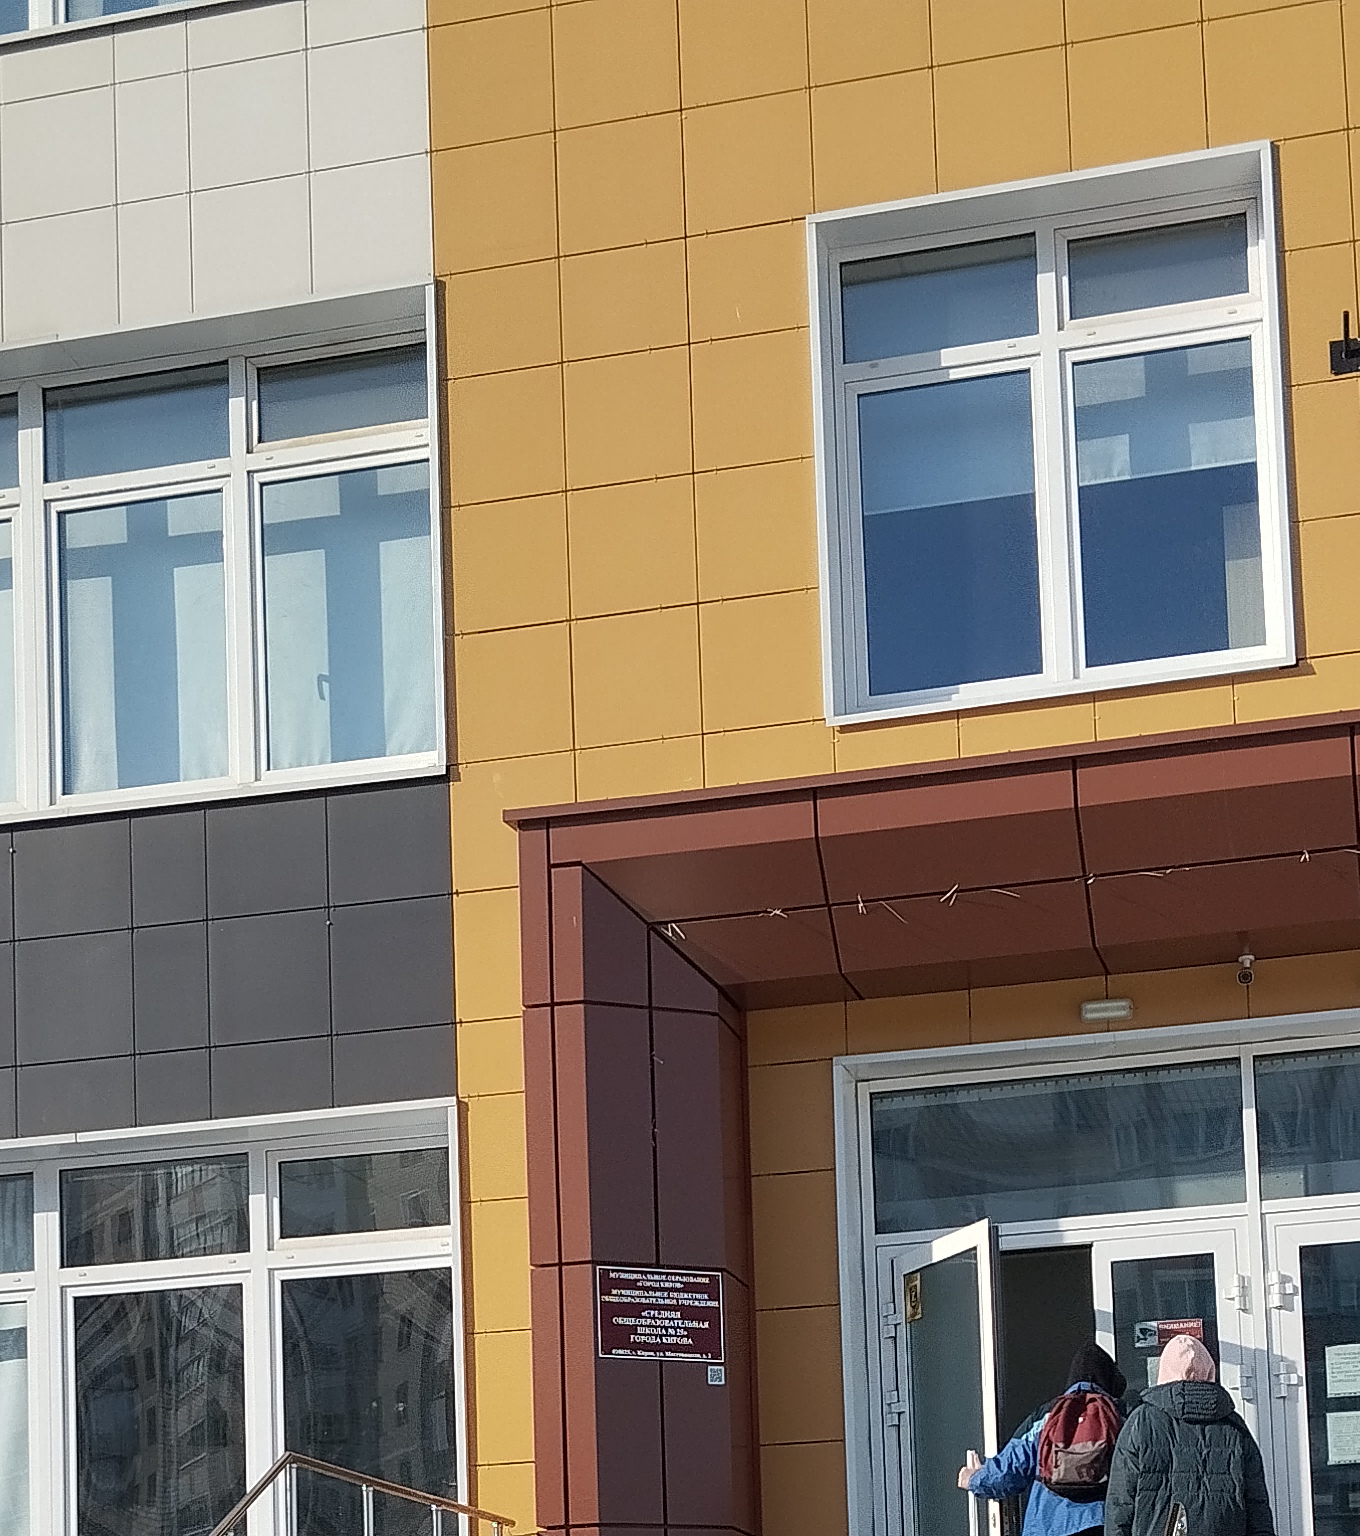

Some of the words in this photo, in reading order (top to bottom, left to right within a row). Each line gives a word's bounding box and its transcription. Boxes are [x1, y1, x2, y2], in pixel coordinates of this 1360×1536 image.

[612, 1317, 709, 1328] ОБЩЕОБРАЗОВАТЕЛЬНАЯ
[637, 1326, 666, 1335] ШКОЛА
[630, 1335, 661, 1344] ГОРОДА
